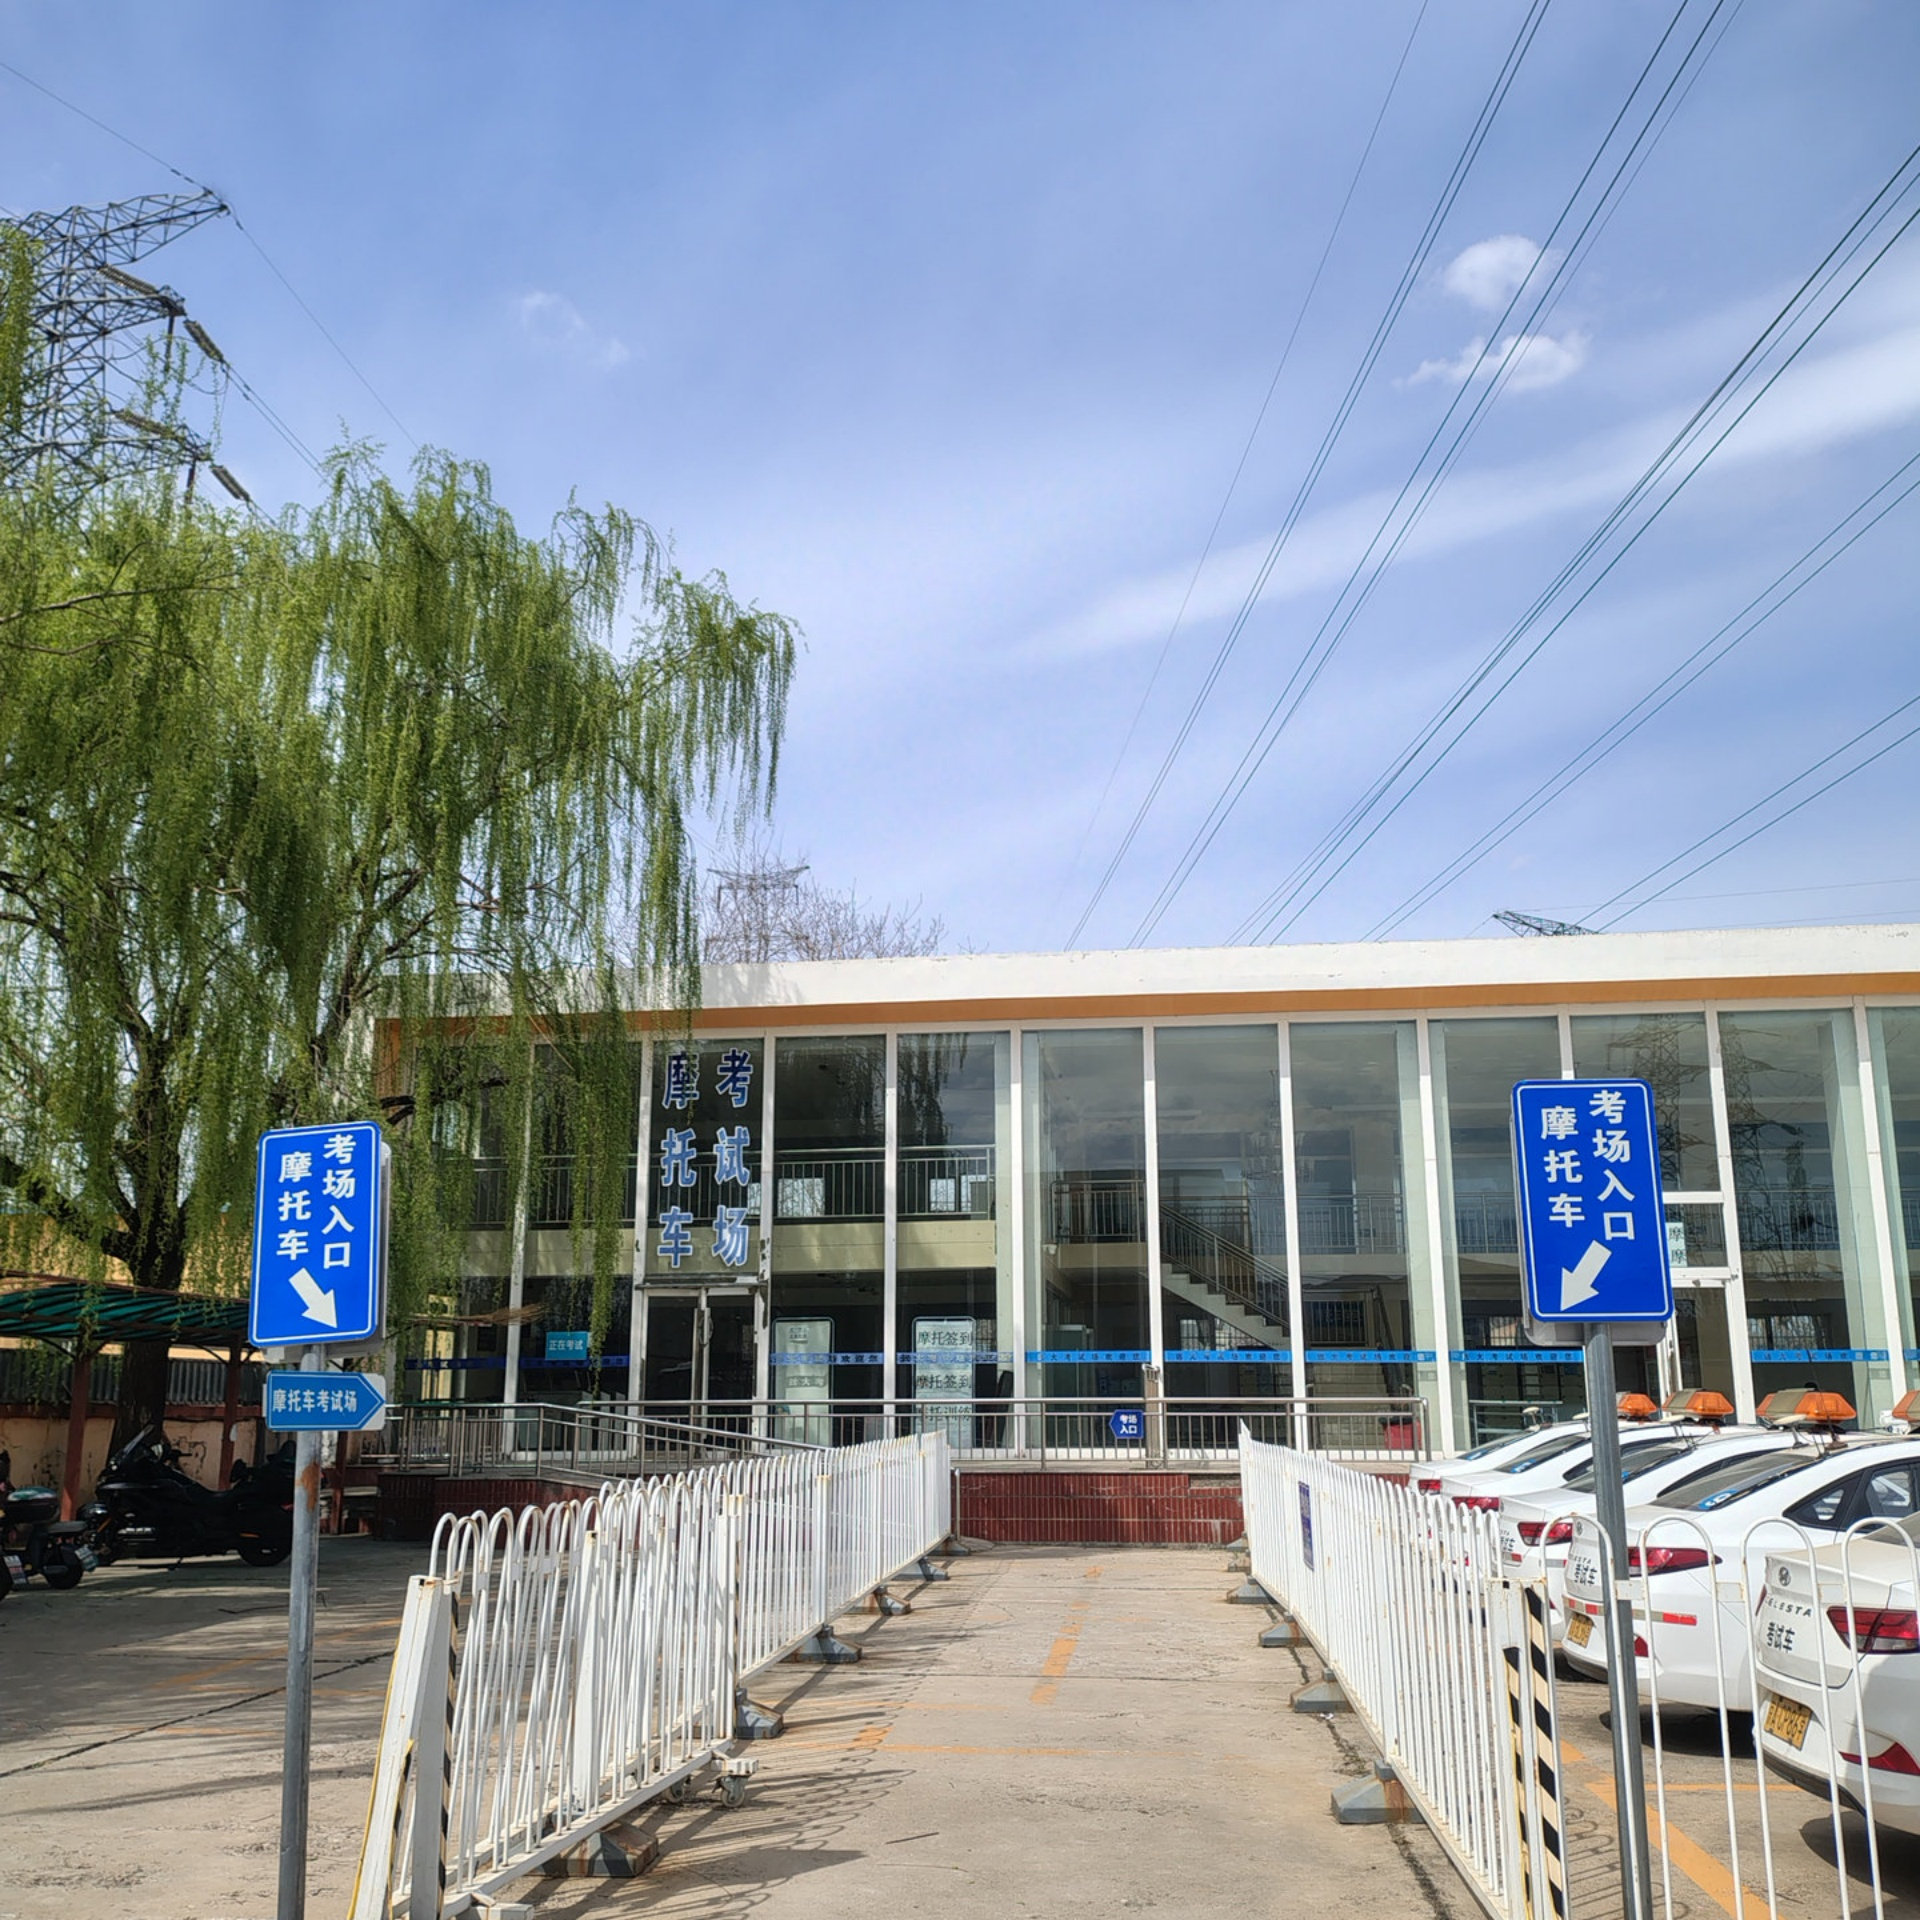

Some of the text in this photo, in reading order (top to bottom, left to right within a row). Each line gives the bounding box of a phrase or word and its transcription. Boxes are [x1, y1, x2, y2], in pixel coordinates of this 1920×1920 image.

[657, 1051, 700, 1268] 摩托车
[712, 1048, 754, 1267] 考试场
[1540, 1105, 1586, 1228] 摩托车
[1589, 1089, 1636, 1241] 考场入口
[275, 1151, 313, 1261] 摩托车
[322, 1133, 357, 1269] 考场入口
[549, 1339, 584, 1351] 正在考试
[918, 1331, 973, 1346] 摩托签到
[916, 1374, 972, 1389] 摩托签到
[272, 1388, 358, 1413] 摩托车考试场
[1119, 1414, 1138, 1425] 考场
[1119, 1425, 1138, 1435] 入口
[1766, 1621, 1796, 1655] 考试车
